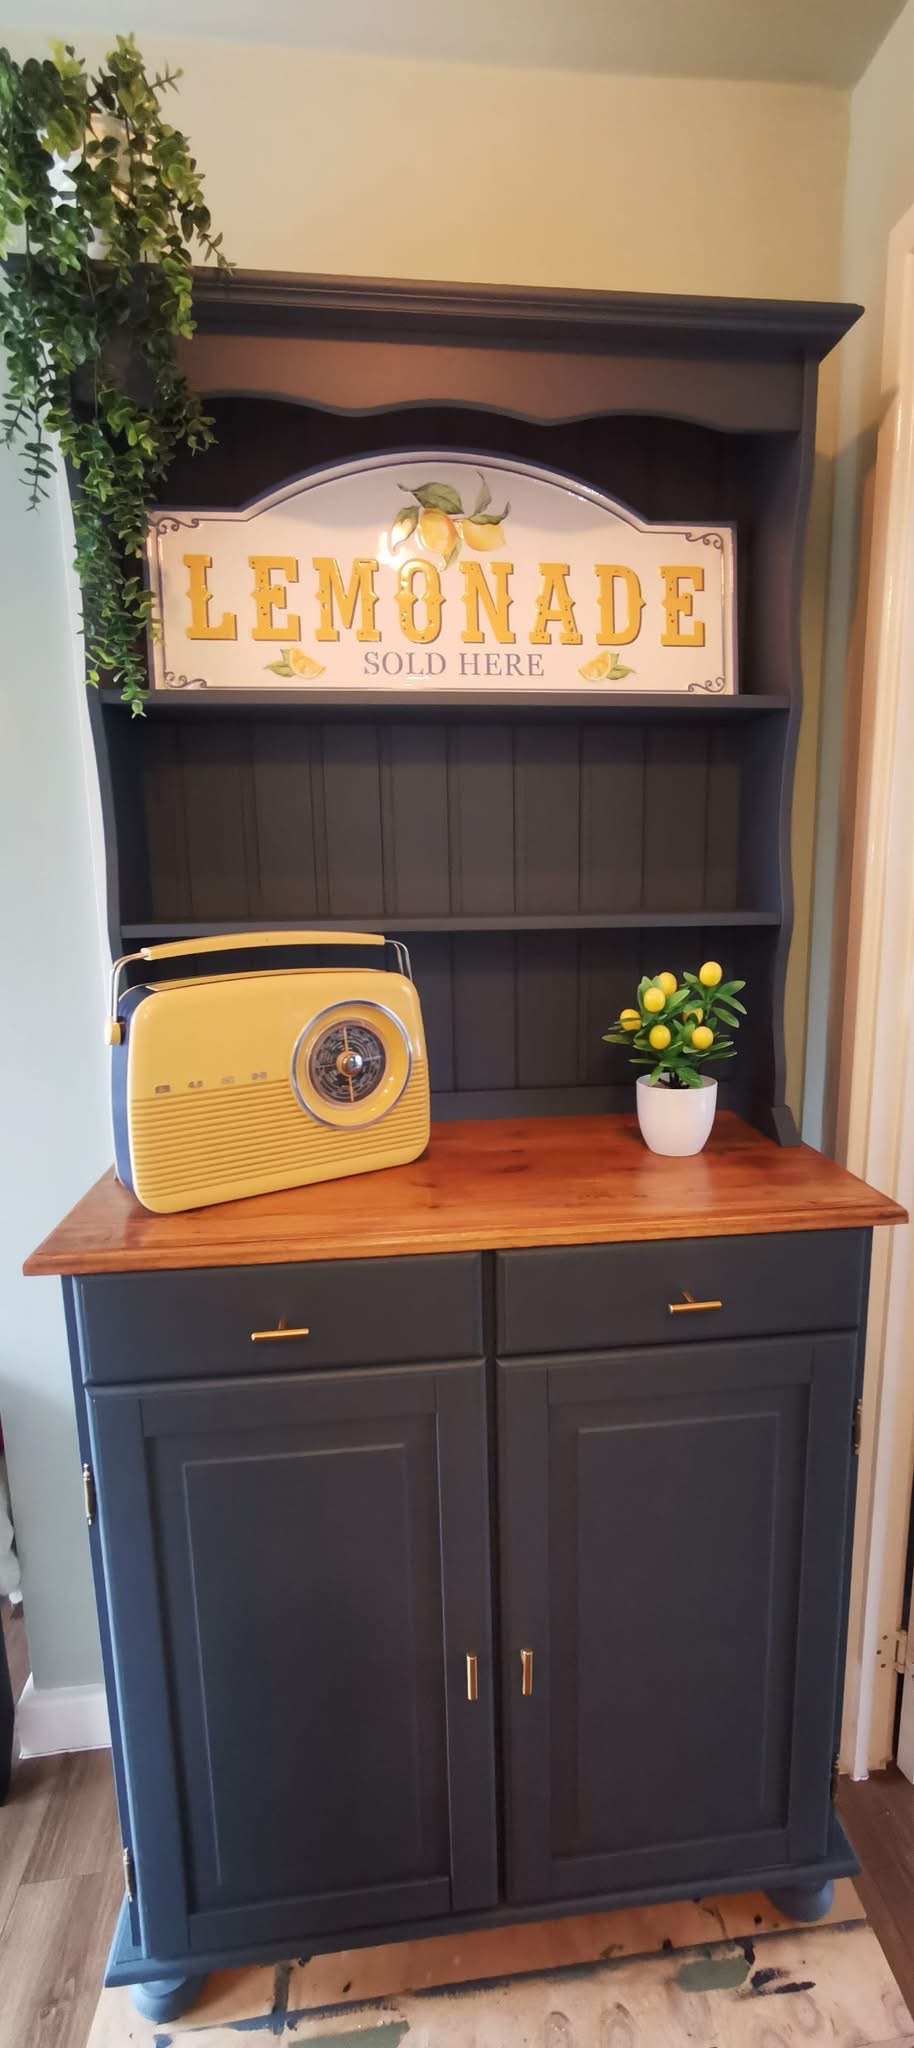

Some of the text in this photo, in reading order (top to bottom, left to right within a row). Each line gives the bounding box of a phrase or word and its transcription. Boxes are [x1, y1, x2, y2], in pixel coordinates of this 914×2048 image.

[183, 553, 706, 647] LEMONADE
[363, 651, 545, 678] SOLD HERE
